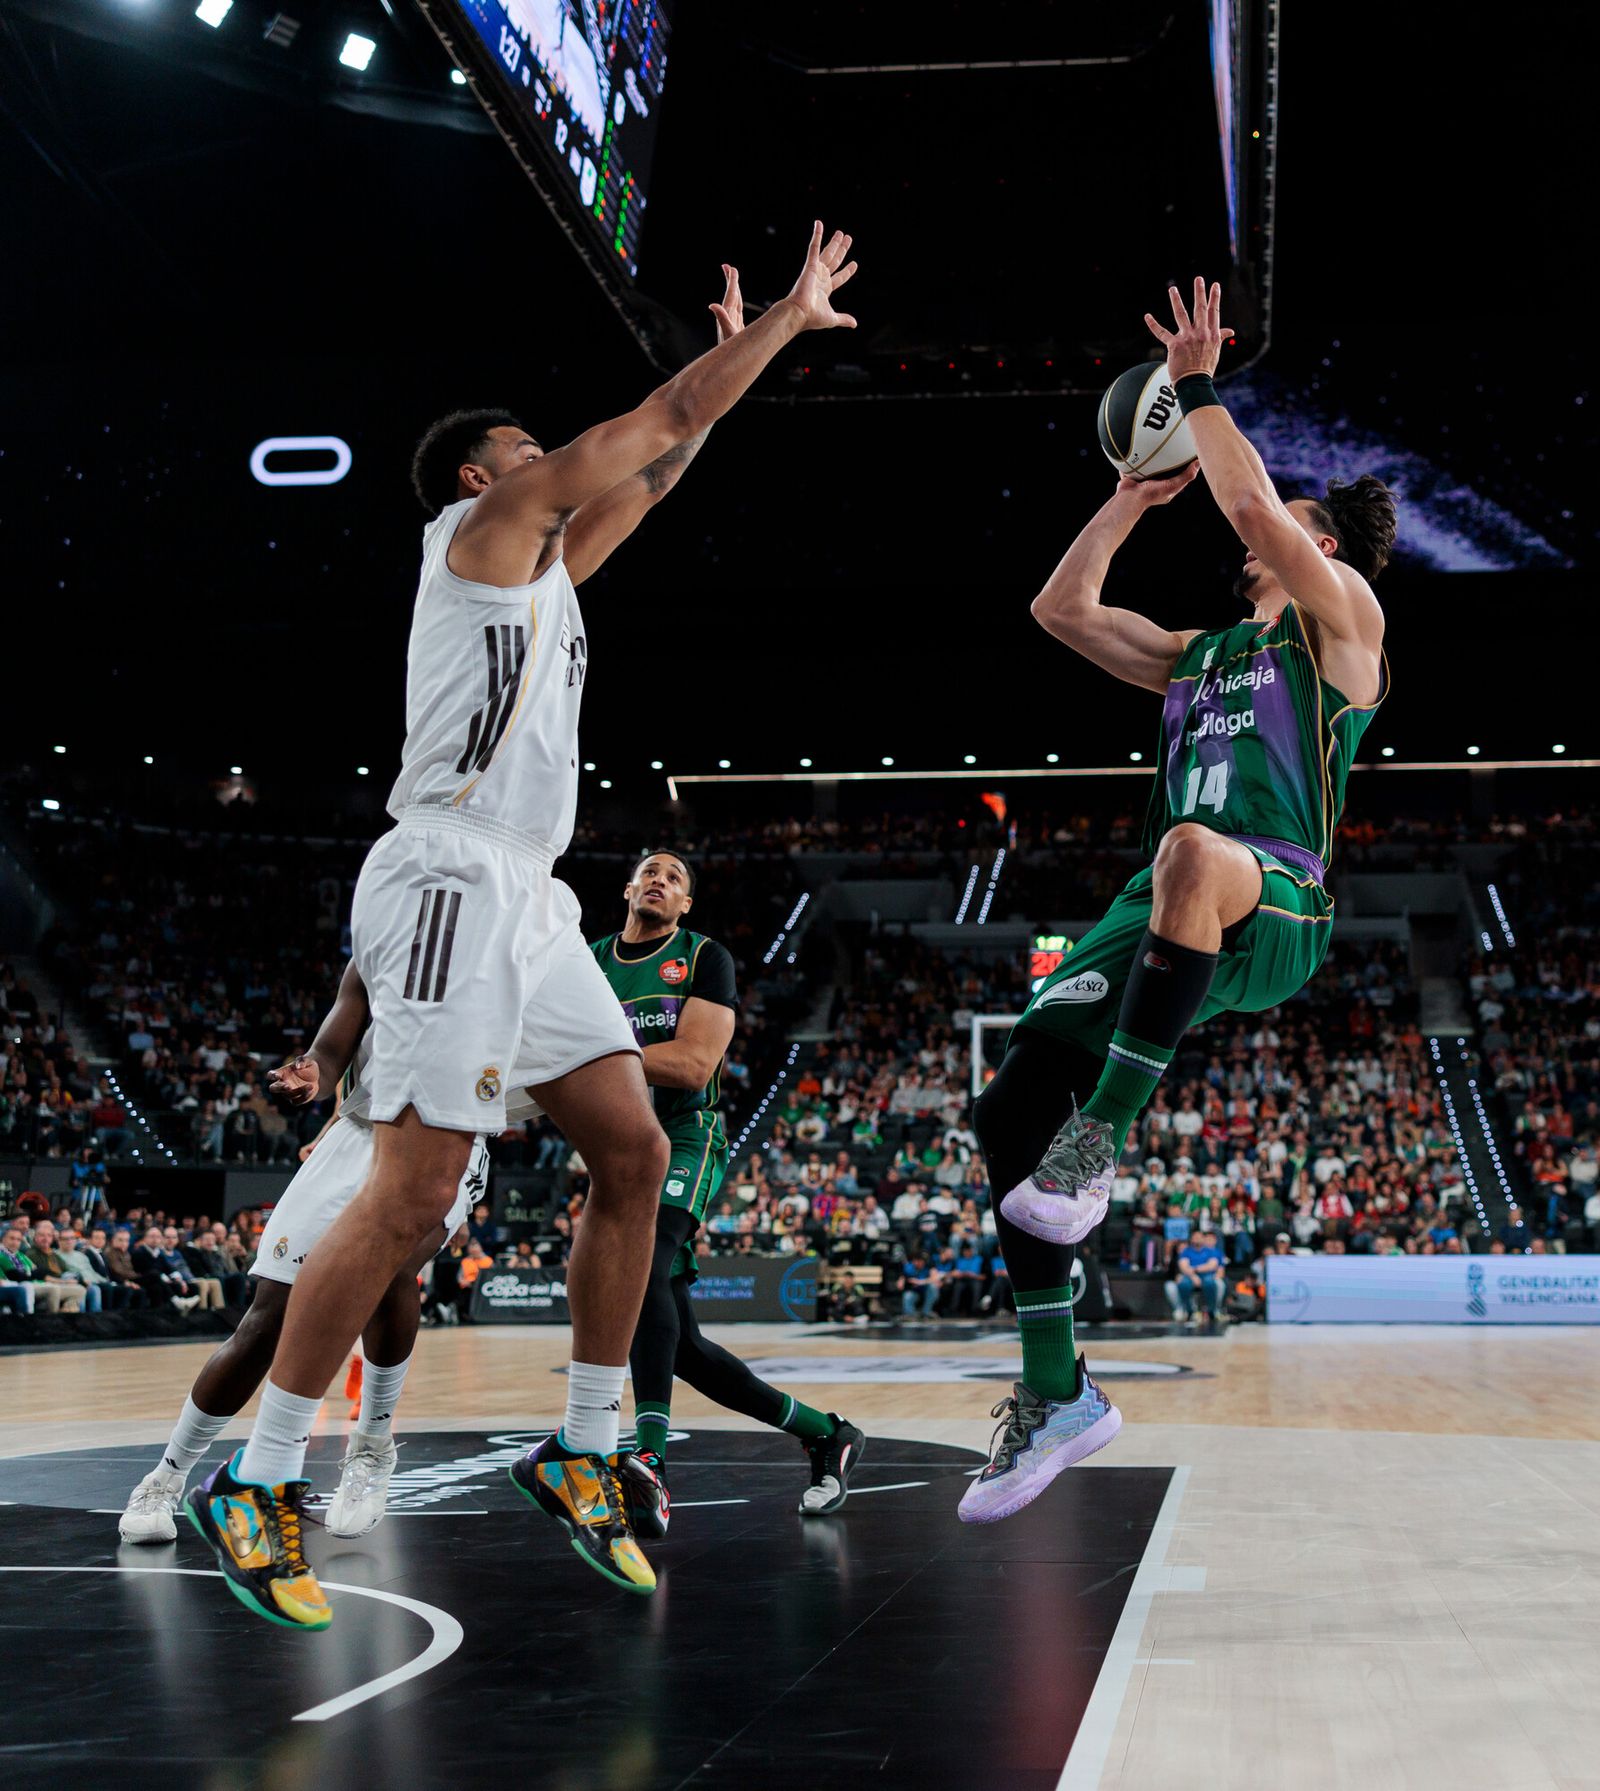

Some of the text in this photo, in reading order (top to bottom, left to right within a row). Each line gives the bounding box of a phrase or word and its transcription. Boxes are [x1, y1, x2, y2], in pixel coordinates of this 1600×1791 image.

[1183, 760, 1228, 817] 14
[627, 1009, 677, 1030] nicaja
[1498, 1275, 1599, 1288] GENERALITAT
[1500, 1292, 1597, 1304] VALENCIANA
